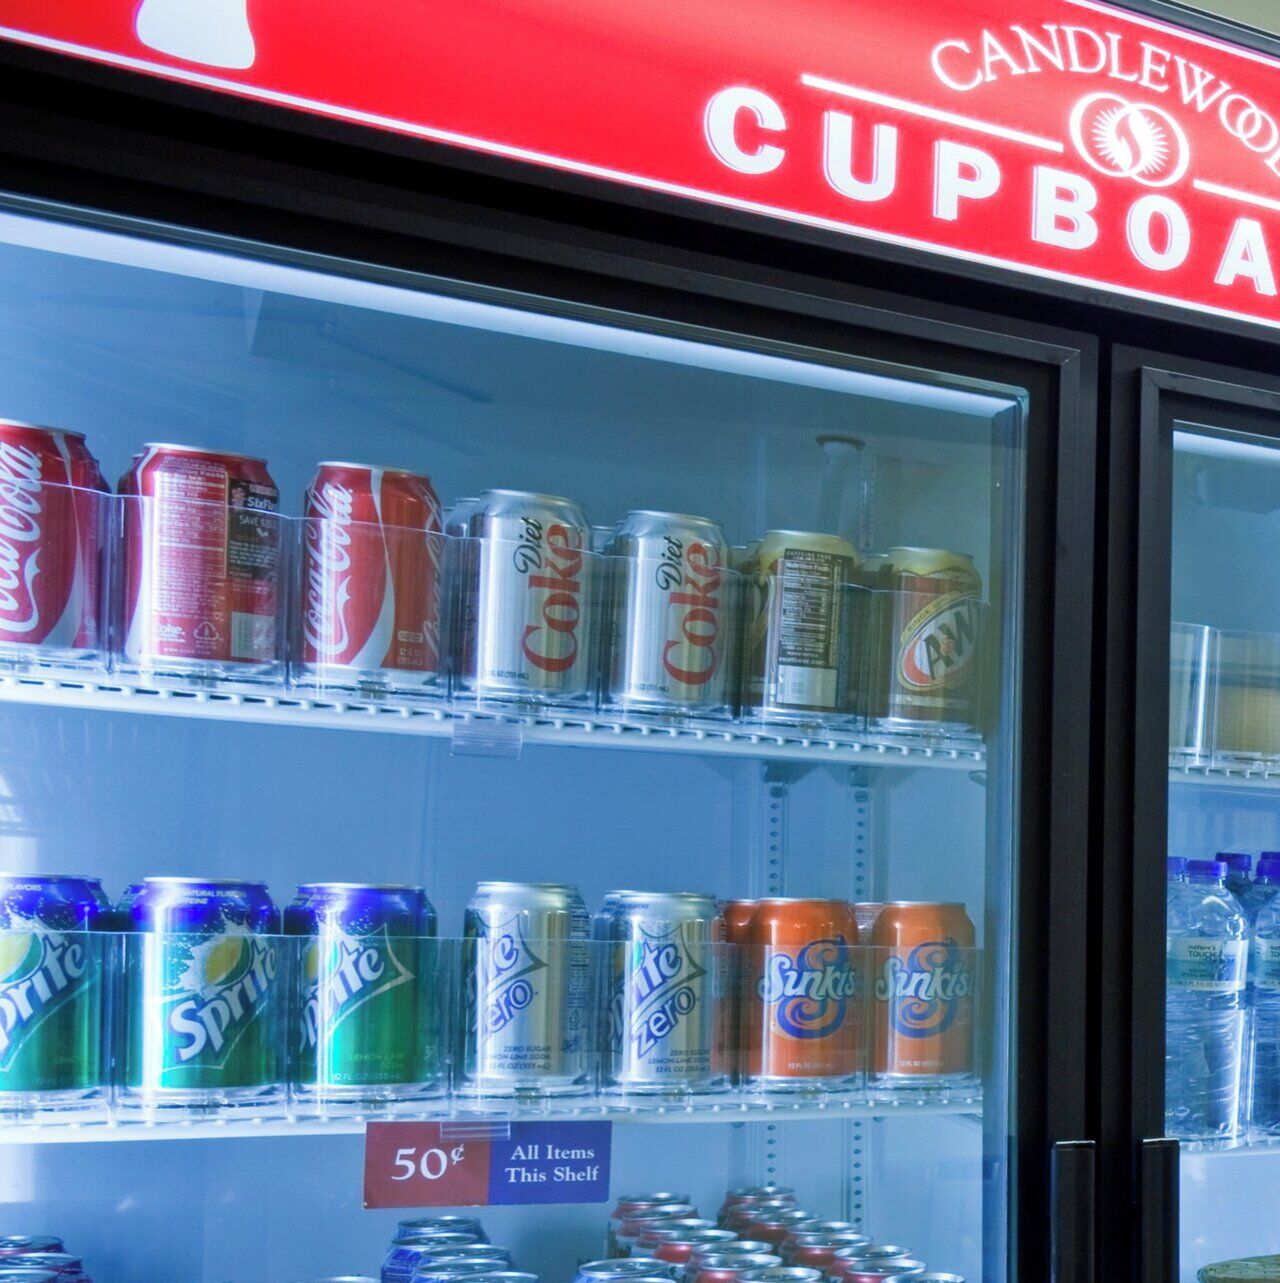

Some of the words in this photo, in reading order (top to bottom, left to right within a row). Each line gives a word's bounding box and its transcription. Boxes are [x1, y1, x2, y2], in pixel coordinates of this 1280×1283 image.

[303, 481, 353, 656] Coca-Cola
[513, 516, 543, 574] Diet
[655, 535, 683, 591] Diet
[522, 523, 583, 672] Coke
[663, 542, 721, 685] Coke
[168, 936, 278, 1063] Sprite
[637, 985, 697, 1060] zero
[390, 1143, 466, 1182] 50¢
[504, 1167, 548, 1184] This
[552, 1165, 599, 1183] Shelf
[510, 1145, 542, 1161] All
[546, 1145, 596, 1161] Items
